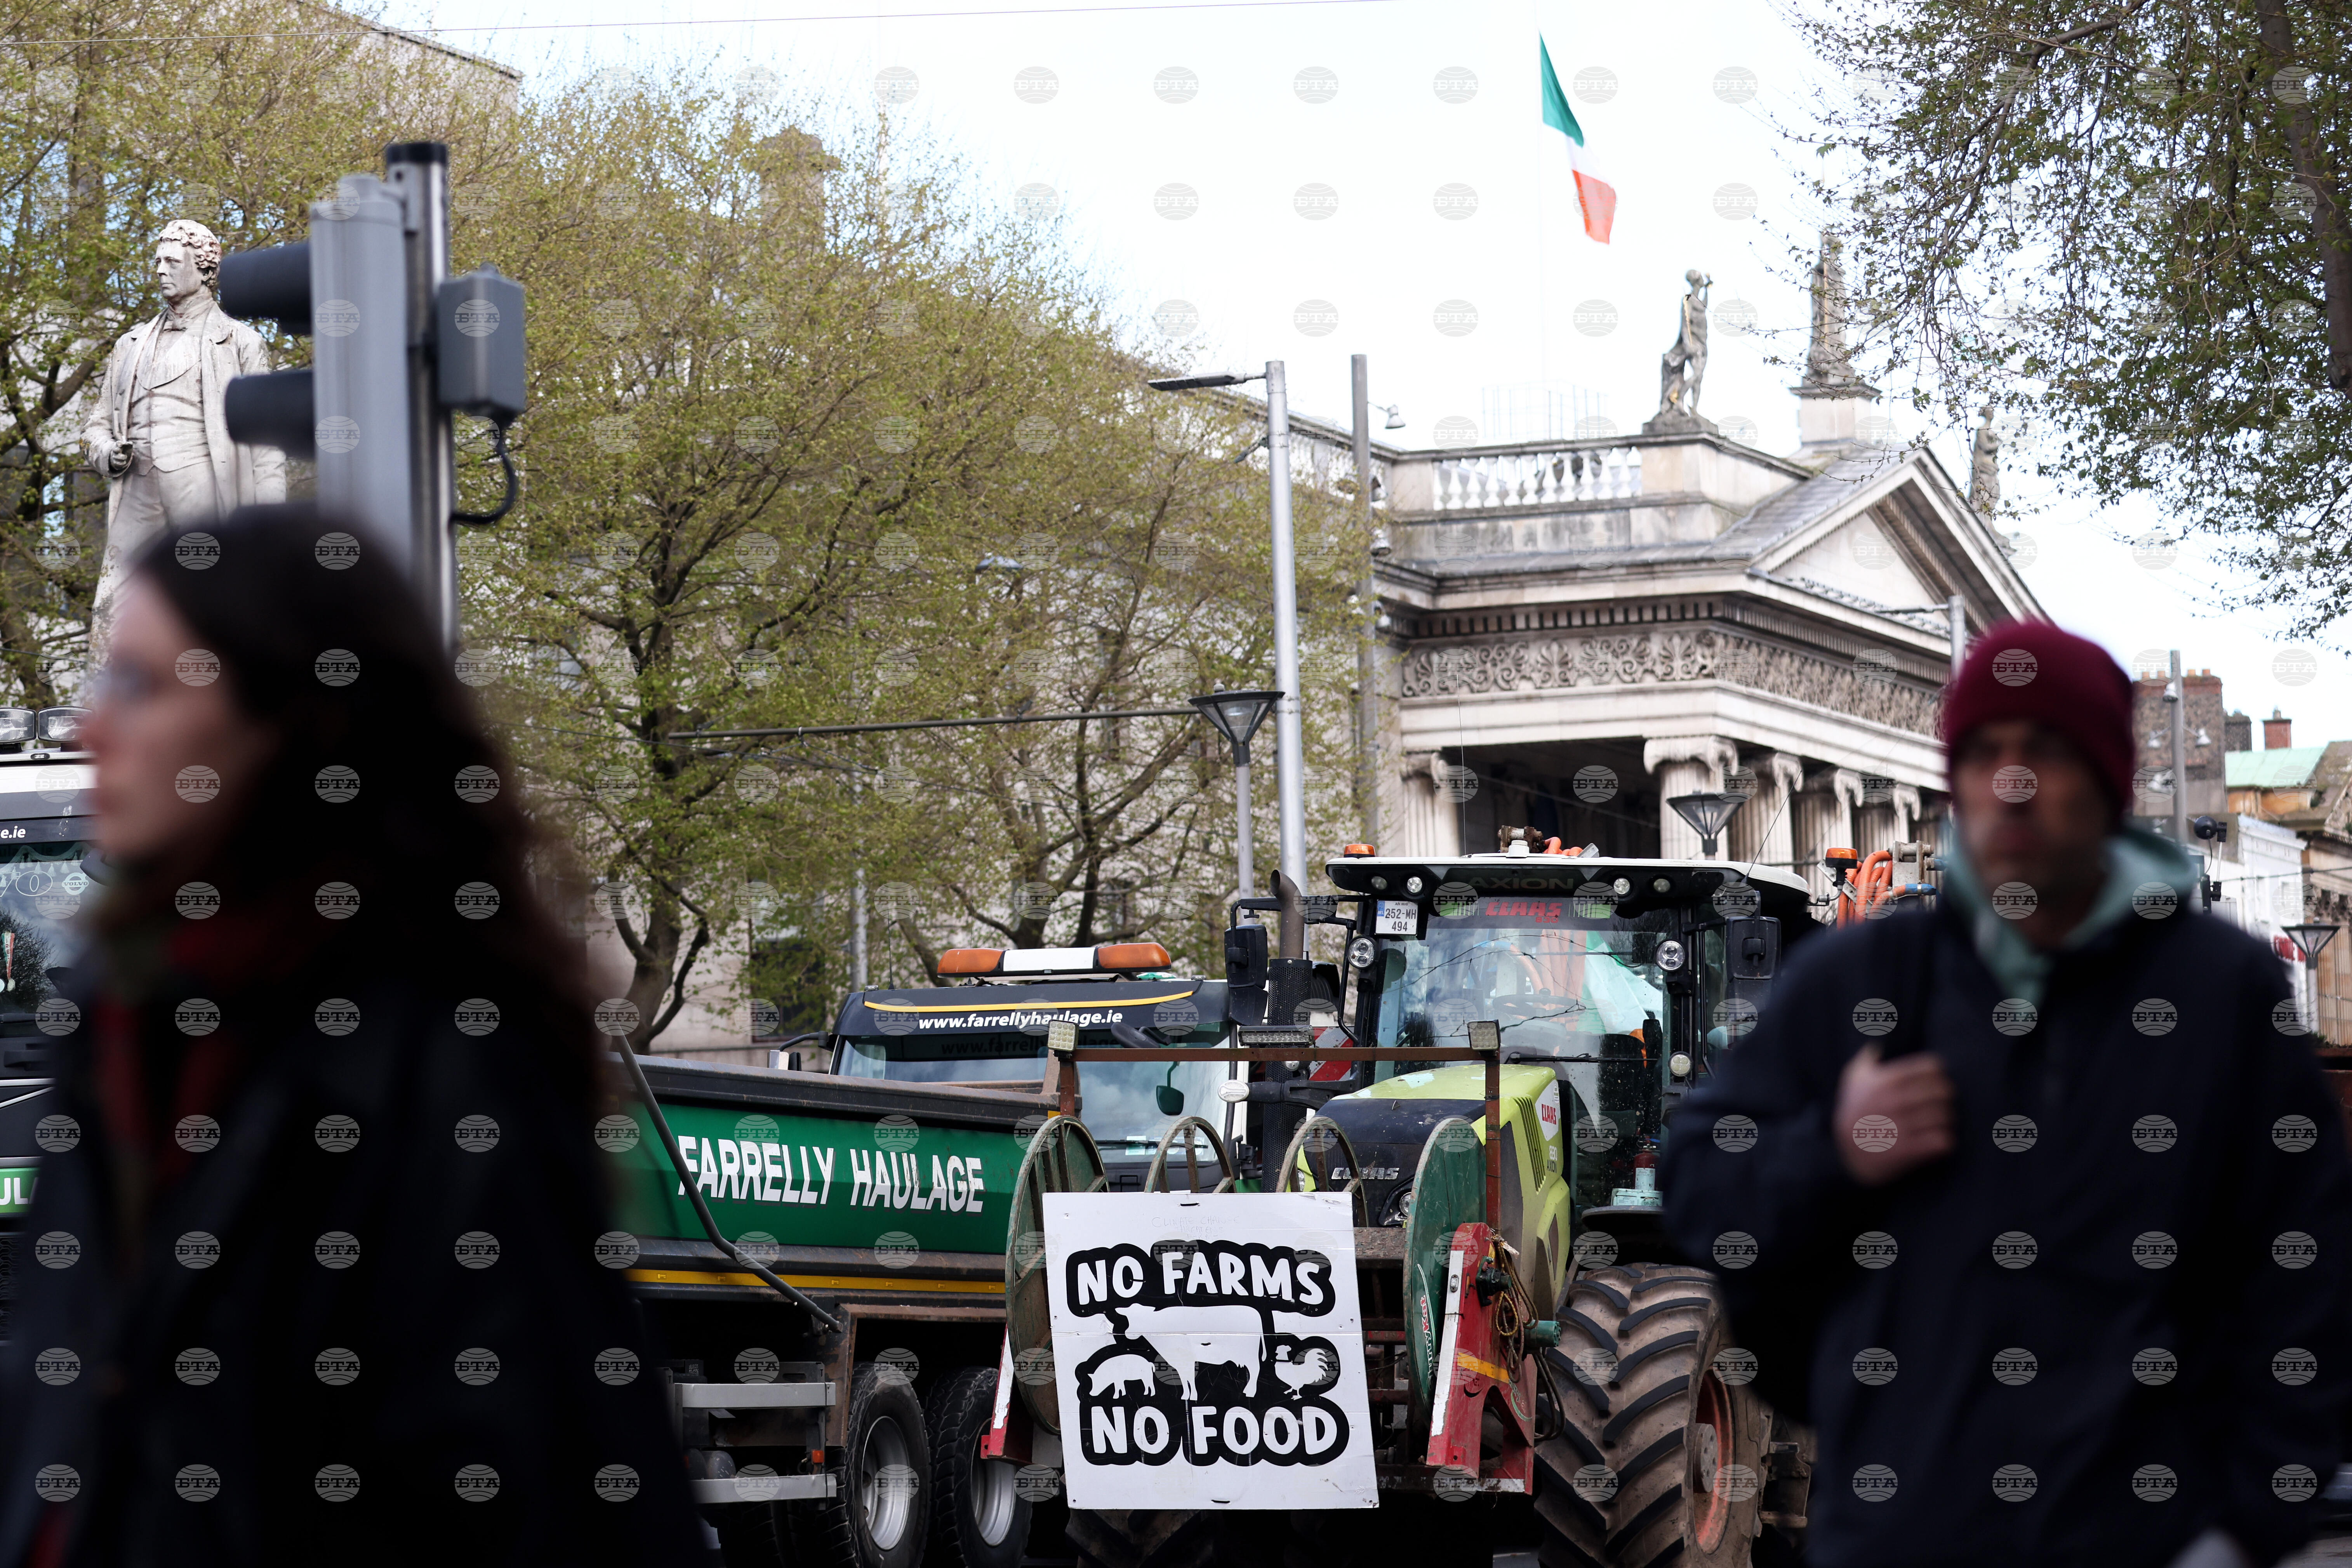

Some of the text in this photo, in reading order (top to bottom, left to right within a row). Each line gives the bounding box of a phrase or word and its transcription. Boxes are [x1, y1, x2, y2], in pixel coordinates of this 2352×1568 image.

[0, 826, 26, 838] e.ie
[1469, 876, 1573, 889] AXION
[1385, 908, 1417, 919] 252-MH
[1485, 902, 1563, 917] CLAAS
[1392, 921, 1407, 931] 494
[1542, 1104, 1556, 1125] CLAAS
[1547, 1159, 1557, 1173] AXION
[678, 1135, 983, 1213] FARRELLY HAULAGE
[1077, 1252, 1324, 1305] NO FARMS
[1091, 1406, 1337, 1455] NO FOOD
